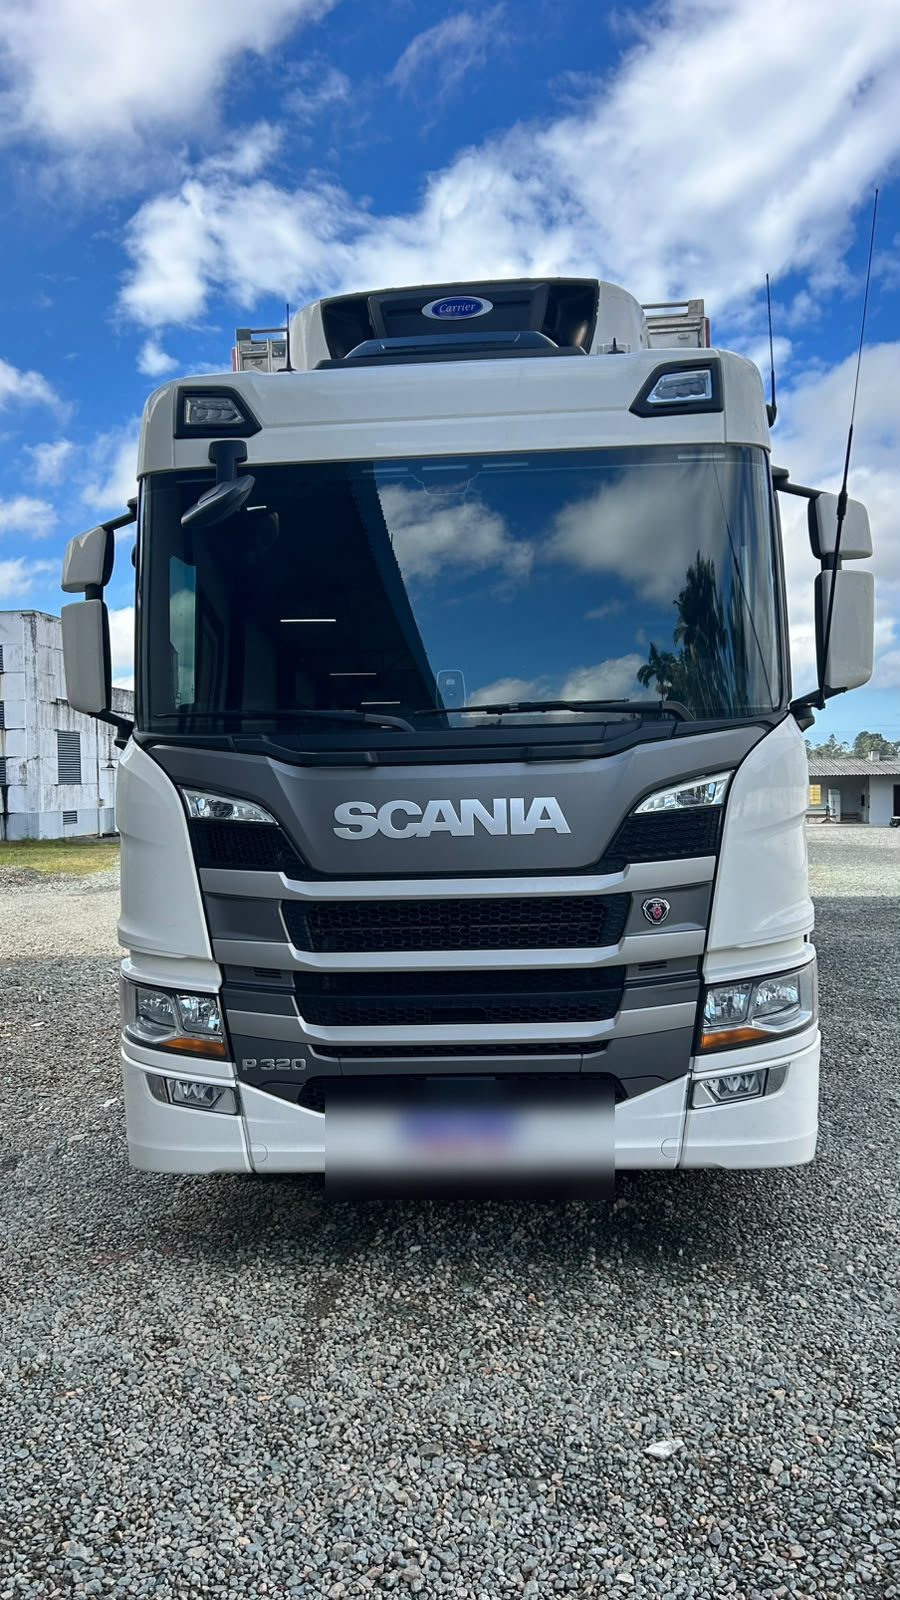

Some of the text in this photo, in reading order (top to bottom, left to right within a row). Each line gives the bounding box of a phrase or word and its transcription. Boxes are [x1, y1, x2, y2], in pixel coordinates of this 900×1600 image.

[439, 302, 476, 313] Carrier
[333, 797, 572, 840] SCANIA
[242, 1058, 307, 1071] P 320
